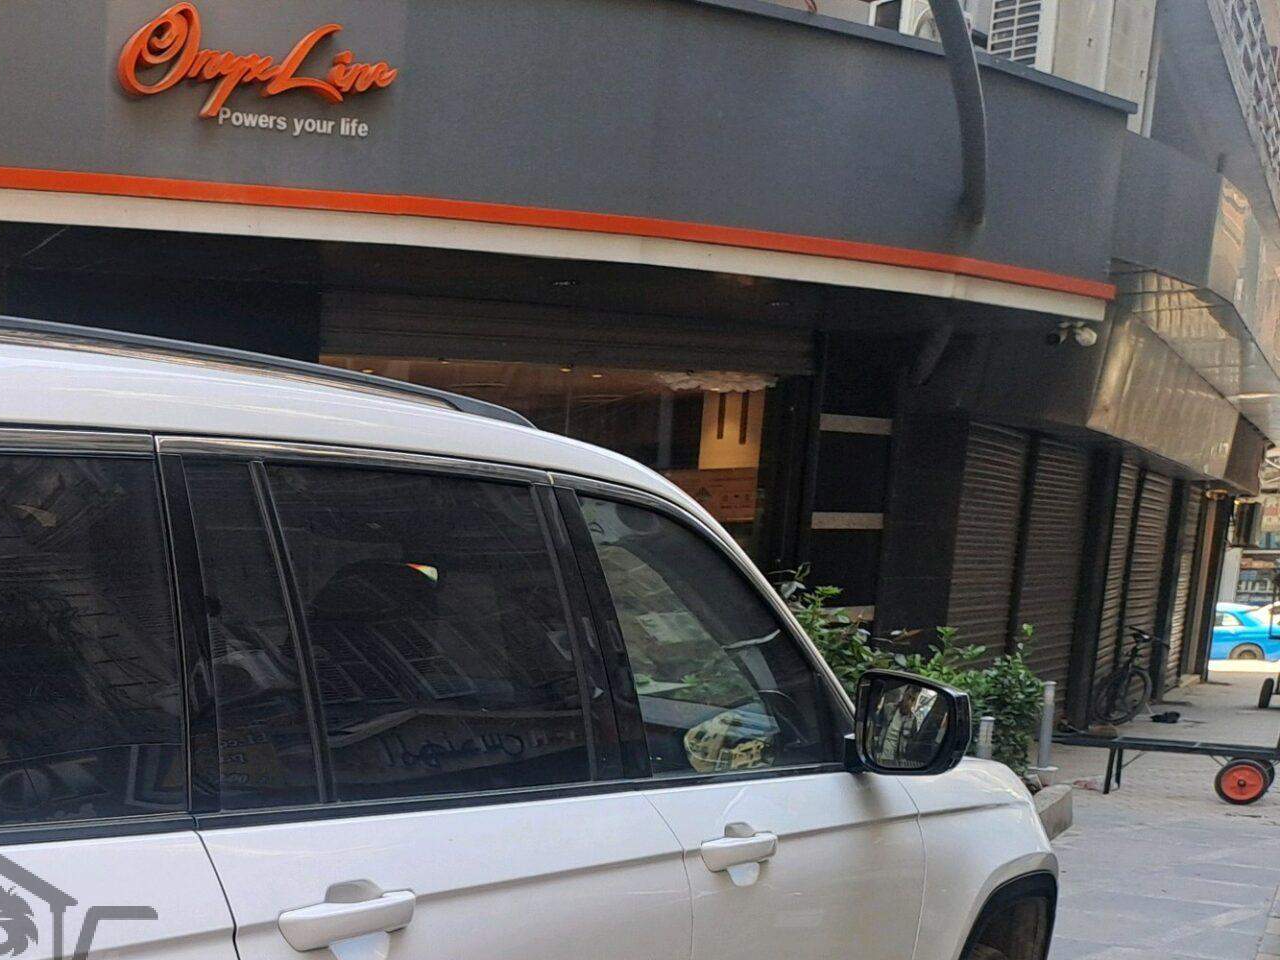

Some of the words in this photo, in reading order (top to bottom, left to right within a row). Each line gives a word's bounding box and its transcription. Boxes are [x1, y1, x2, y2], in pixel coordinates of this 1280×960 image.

[218, 107, 288, 131] Powers
[292, 116, 336, 137] your
[340, 117, 370, 138] life
